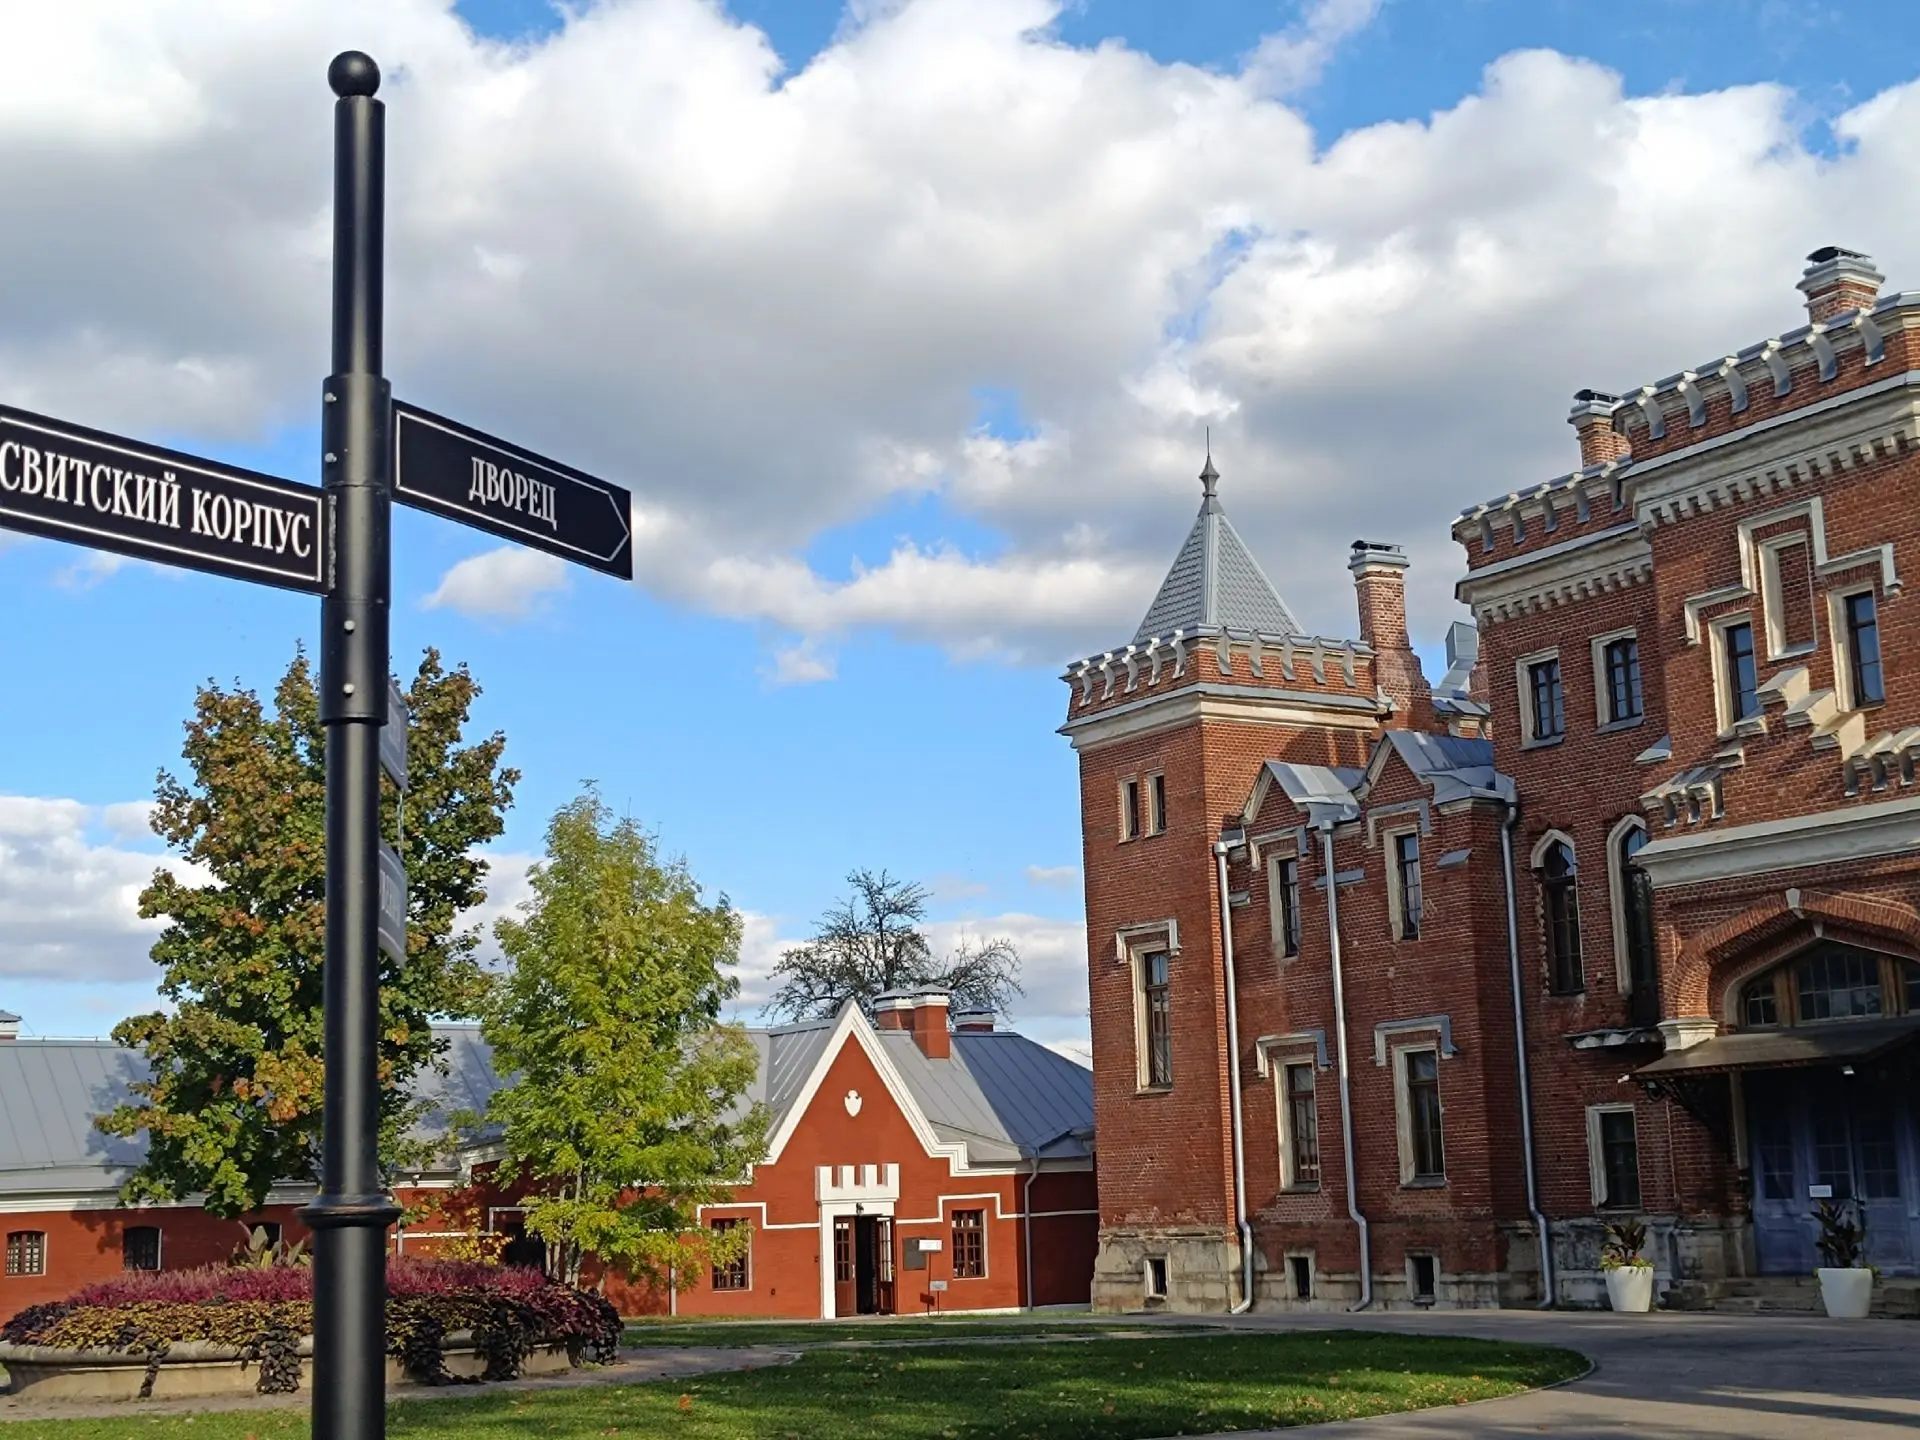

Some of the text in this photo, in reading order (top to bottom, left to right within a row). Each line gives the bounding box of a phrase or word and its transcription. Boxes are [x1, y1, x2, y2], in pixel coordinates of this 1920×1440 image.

[0, 441, 311, 557] СВИТСКИЙ КОРПУС
[468, 456, 558, 531] ДВОРЕЦ
